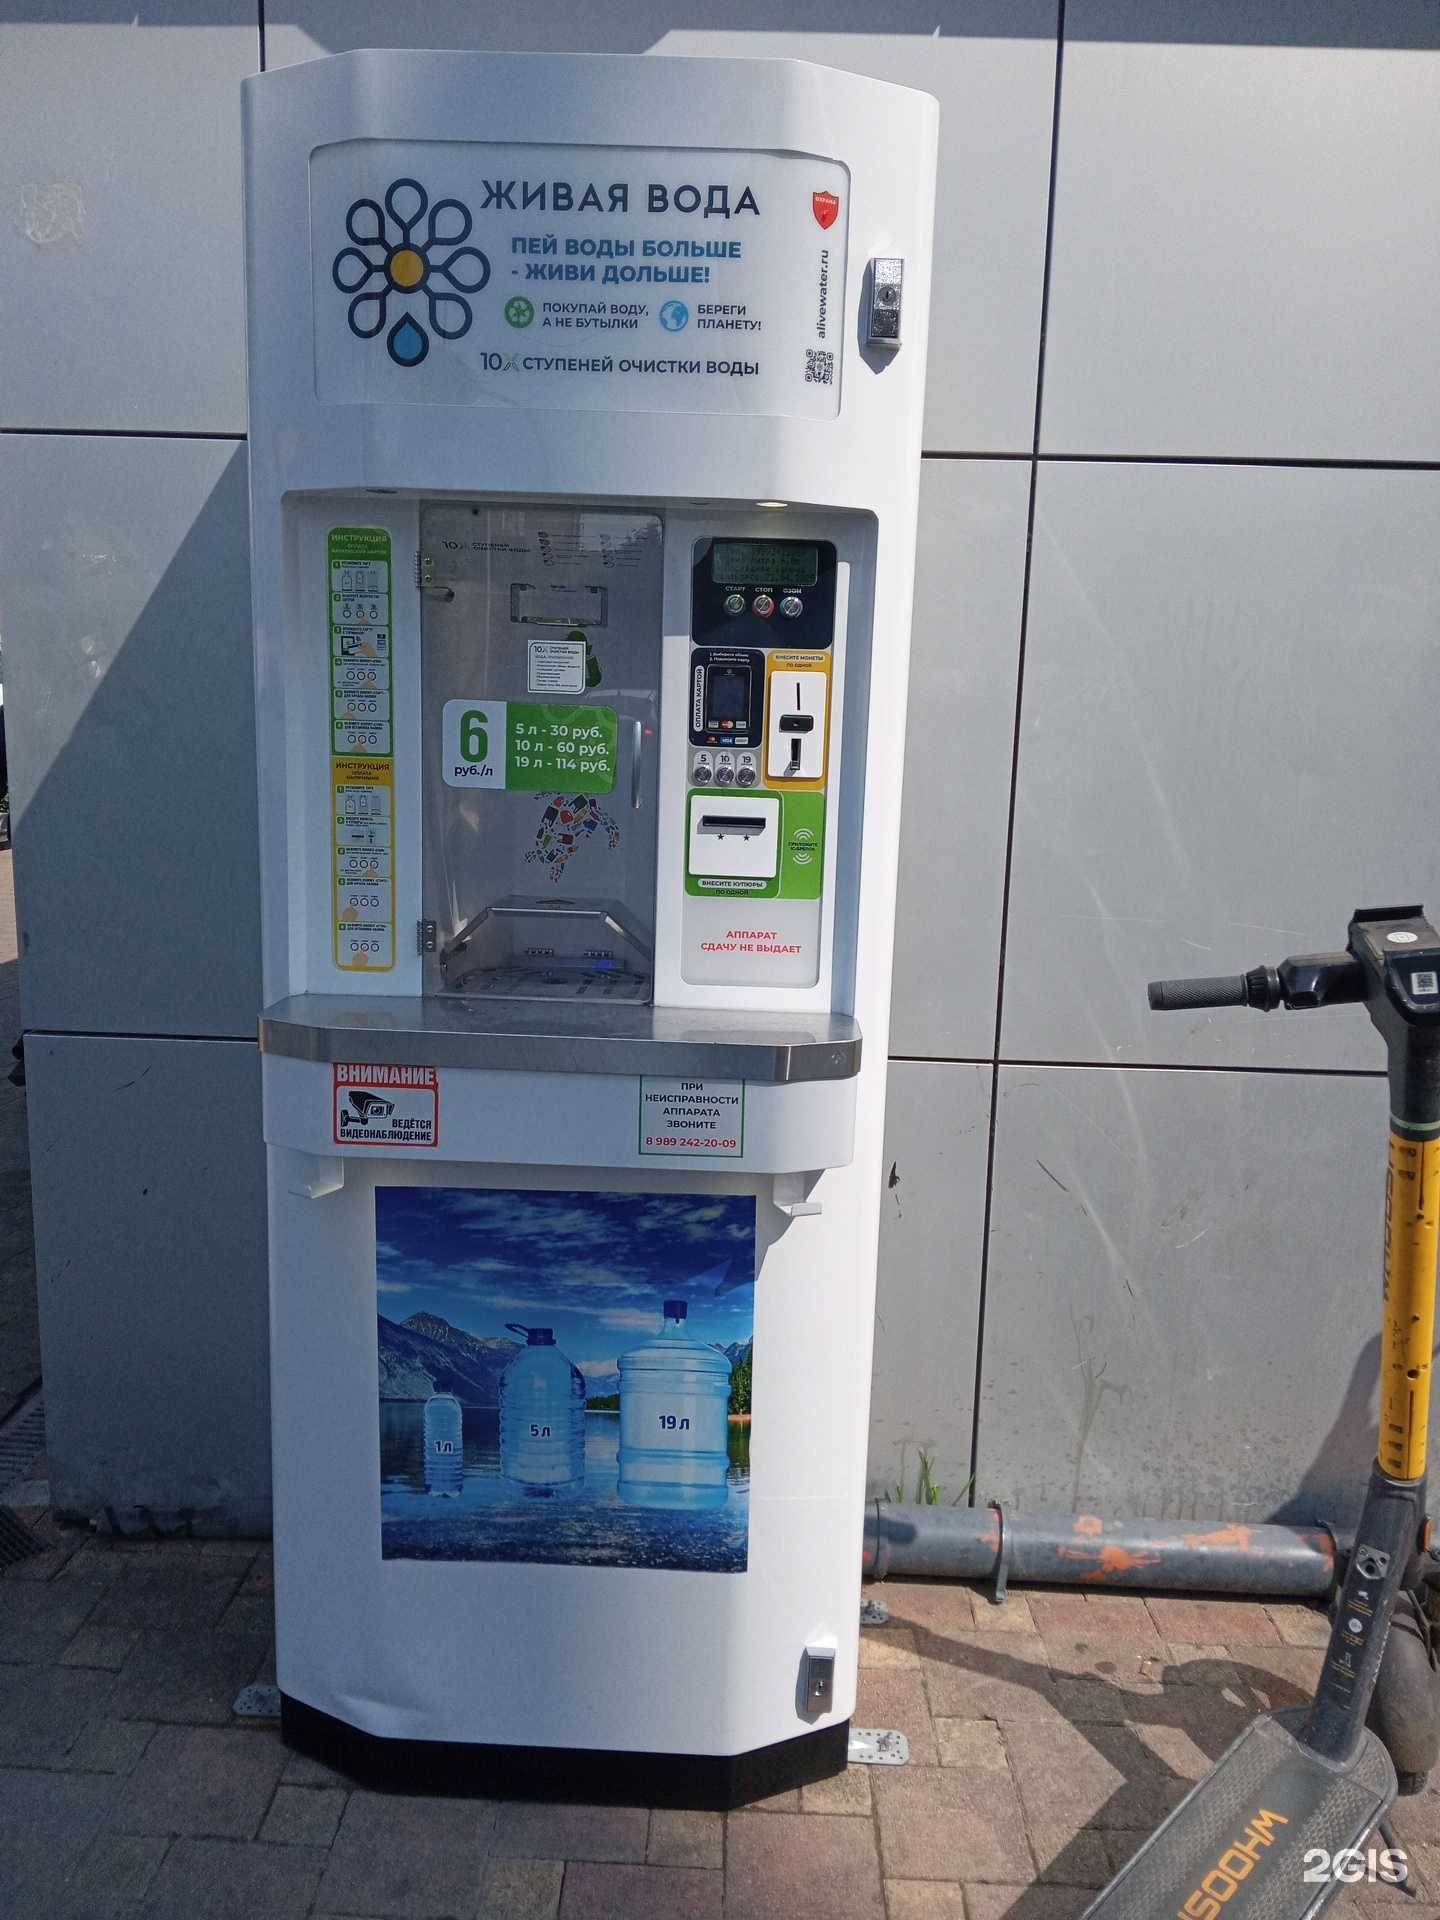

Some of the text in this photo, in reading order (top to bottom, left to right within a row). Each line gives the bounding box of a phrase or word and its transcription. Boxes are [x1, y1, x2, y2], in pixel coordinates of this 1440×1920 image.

[480, 180, 760, 219] ЖИВАЯ ВОДА
[511, 234, 742, 259] ПЕЙ ВОДЫ БОЛЬШЕ
[525, 263, 596, 282] ЖИВИ
[602, 265, 710, 285] ДОЛЬШЕ!
[816, 250, 829, 339] alivewater.ru
[542, 301, 650, 317] ПОКУПАЙ ВОДУ,
[697, 303, 747, 316] БЕРЕГИ
[542, 318, 639, 330] А НЕ БУТЫЛКИ
[697, 319, 762, 331] ПЛАНЕТУ!
[523, 354, 613, 373] СТУПЕНЕЙ
[618, 359, 700, 375] ОЧИСТКИ
[705, 360, 760, 376] ВОДЫ
[460, 709, 489, 763] 6
[515, 723, 525, 735] 5
[528, 725, 537, 735] л
[550, 725, 568, 737] 30
[572, 726, 602, 741] руб.
[515, 740, 530, 752] 10
[533, 742, 544, 752] л
[557, 742, 575, 754] 60
[579, 743, 609, 757] руб.
[515, 756, 530, 768] 19
[533, 758, 543, 769] л
[556, 758, 577, 770] 114
[580, 759, 611, 773] руб.
[700, 754, 707, 762] 5
[720, 755, 730, 763] 10
[335, 763, 390, 772] ИНСТРУКЦИЯ
[454, 764, 493, 778] руб./л
[702, 880, 763, 889] ВНЕСИТЕ КУПЮРЫ
[726, 930, 778, 941] АППАРАТ
[700, 942, 802, 955] СДАЧУ НЕ ВЫДАЕТ
[337, 1063, 435, 1086] ВНИМАНИЕ
[681, 1082, 703, 1091] ПРИ
[645, 1094, 739, 1105] НЕИСПРАВНОСТИ
[663, 1107, 721, 1117] АППАРАТА
[392, 1117, 432, 1130] ВЕДЁТСЯ
[666, 1120, 717, 1129] ЗВОНИТЕ
[340, 1128, 432, 1142] ВИДЕОНАБЛЮДЕНИЕ
[646, 1136, 737, 1149] 8 989 242-20-09
[1177, 1808, 1289, 1920] WHOOS
